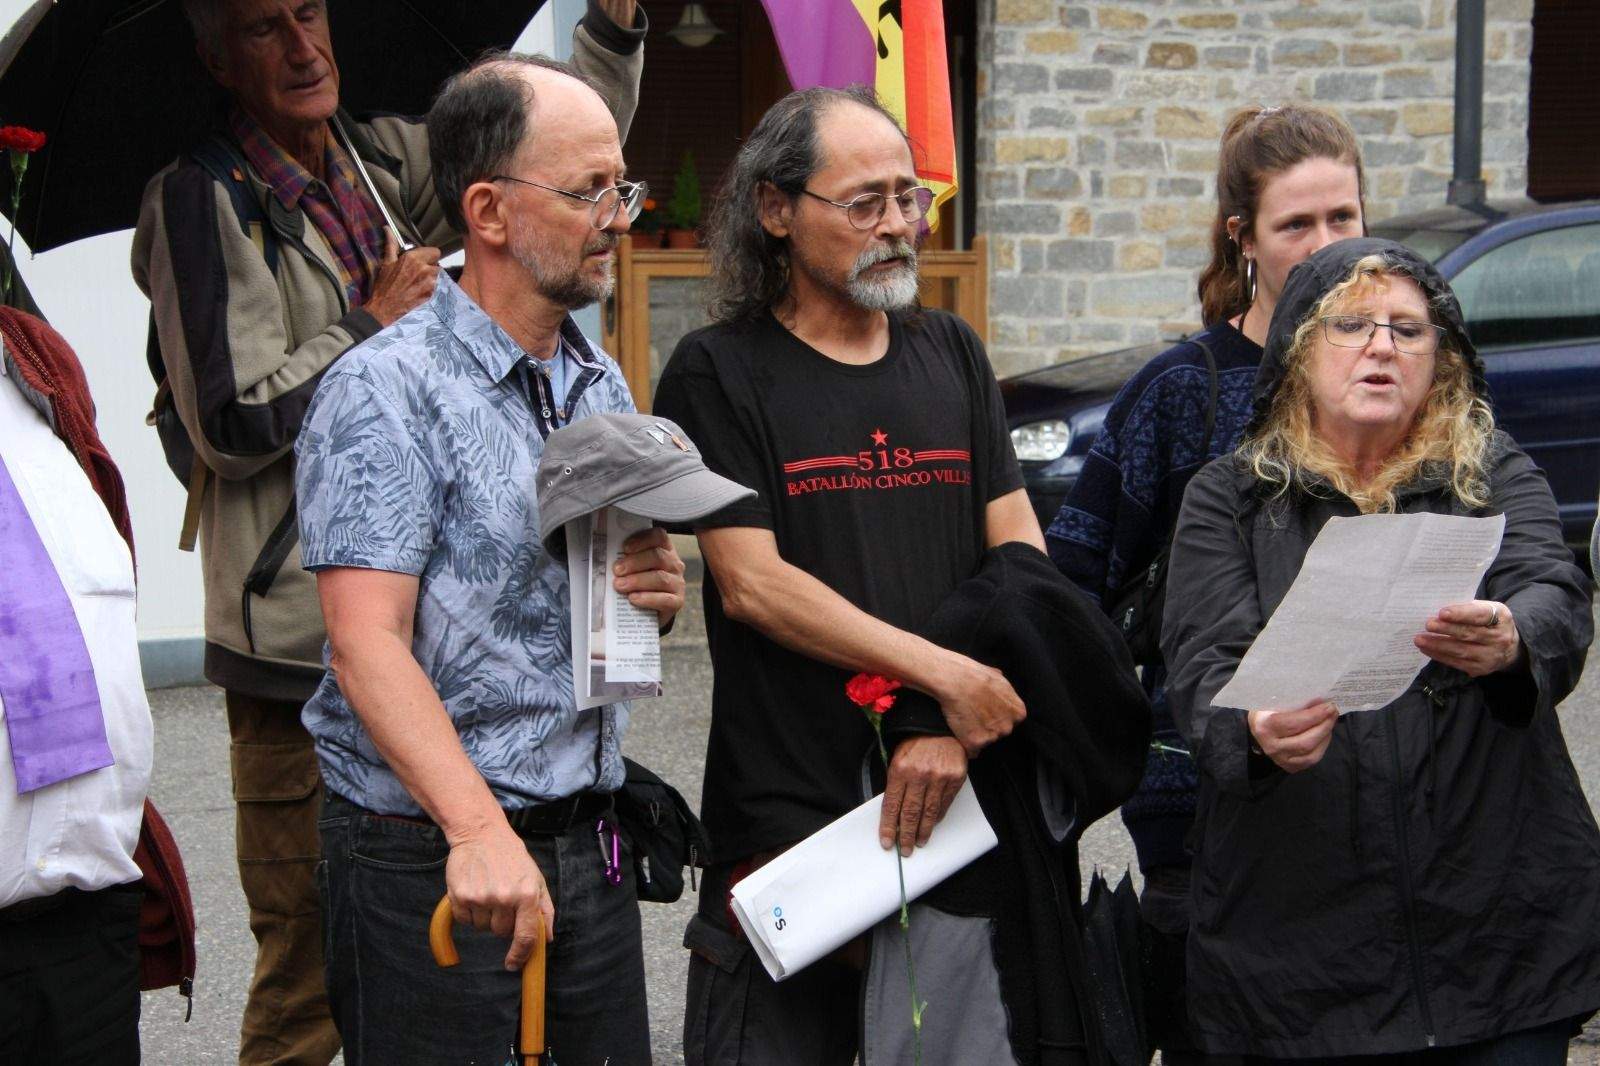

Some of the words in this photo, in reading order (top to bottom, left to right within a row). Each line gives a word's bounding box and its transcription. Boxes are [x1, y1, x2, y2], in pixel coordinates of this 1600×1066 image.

[858, 447, 914, 471] 518
[787, 472, 872, 497] BATALLÓN
[875, 470, 931, 490] CINCO
